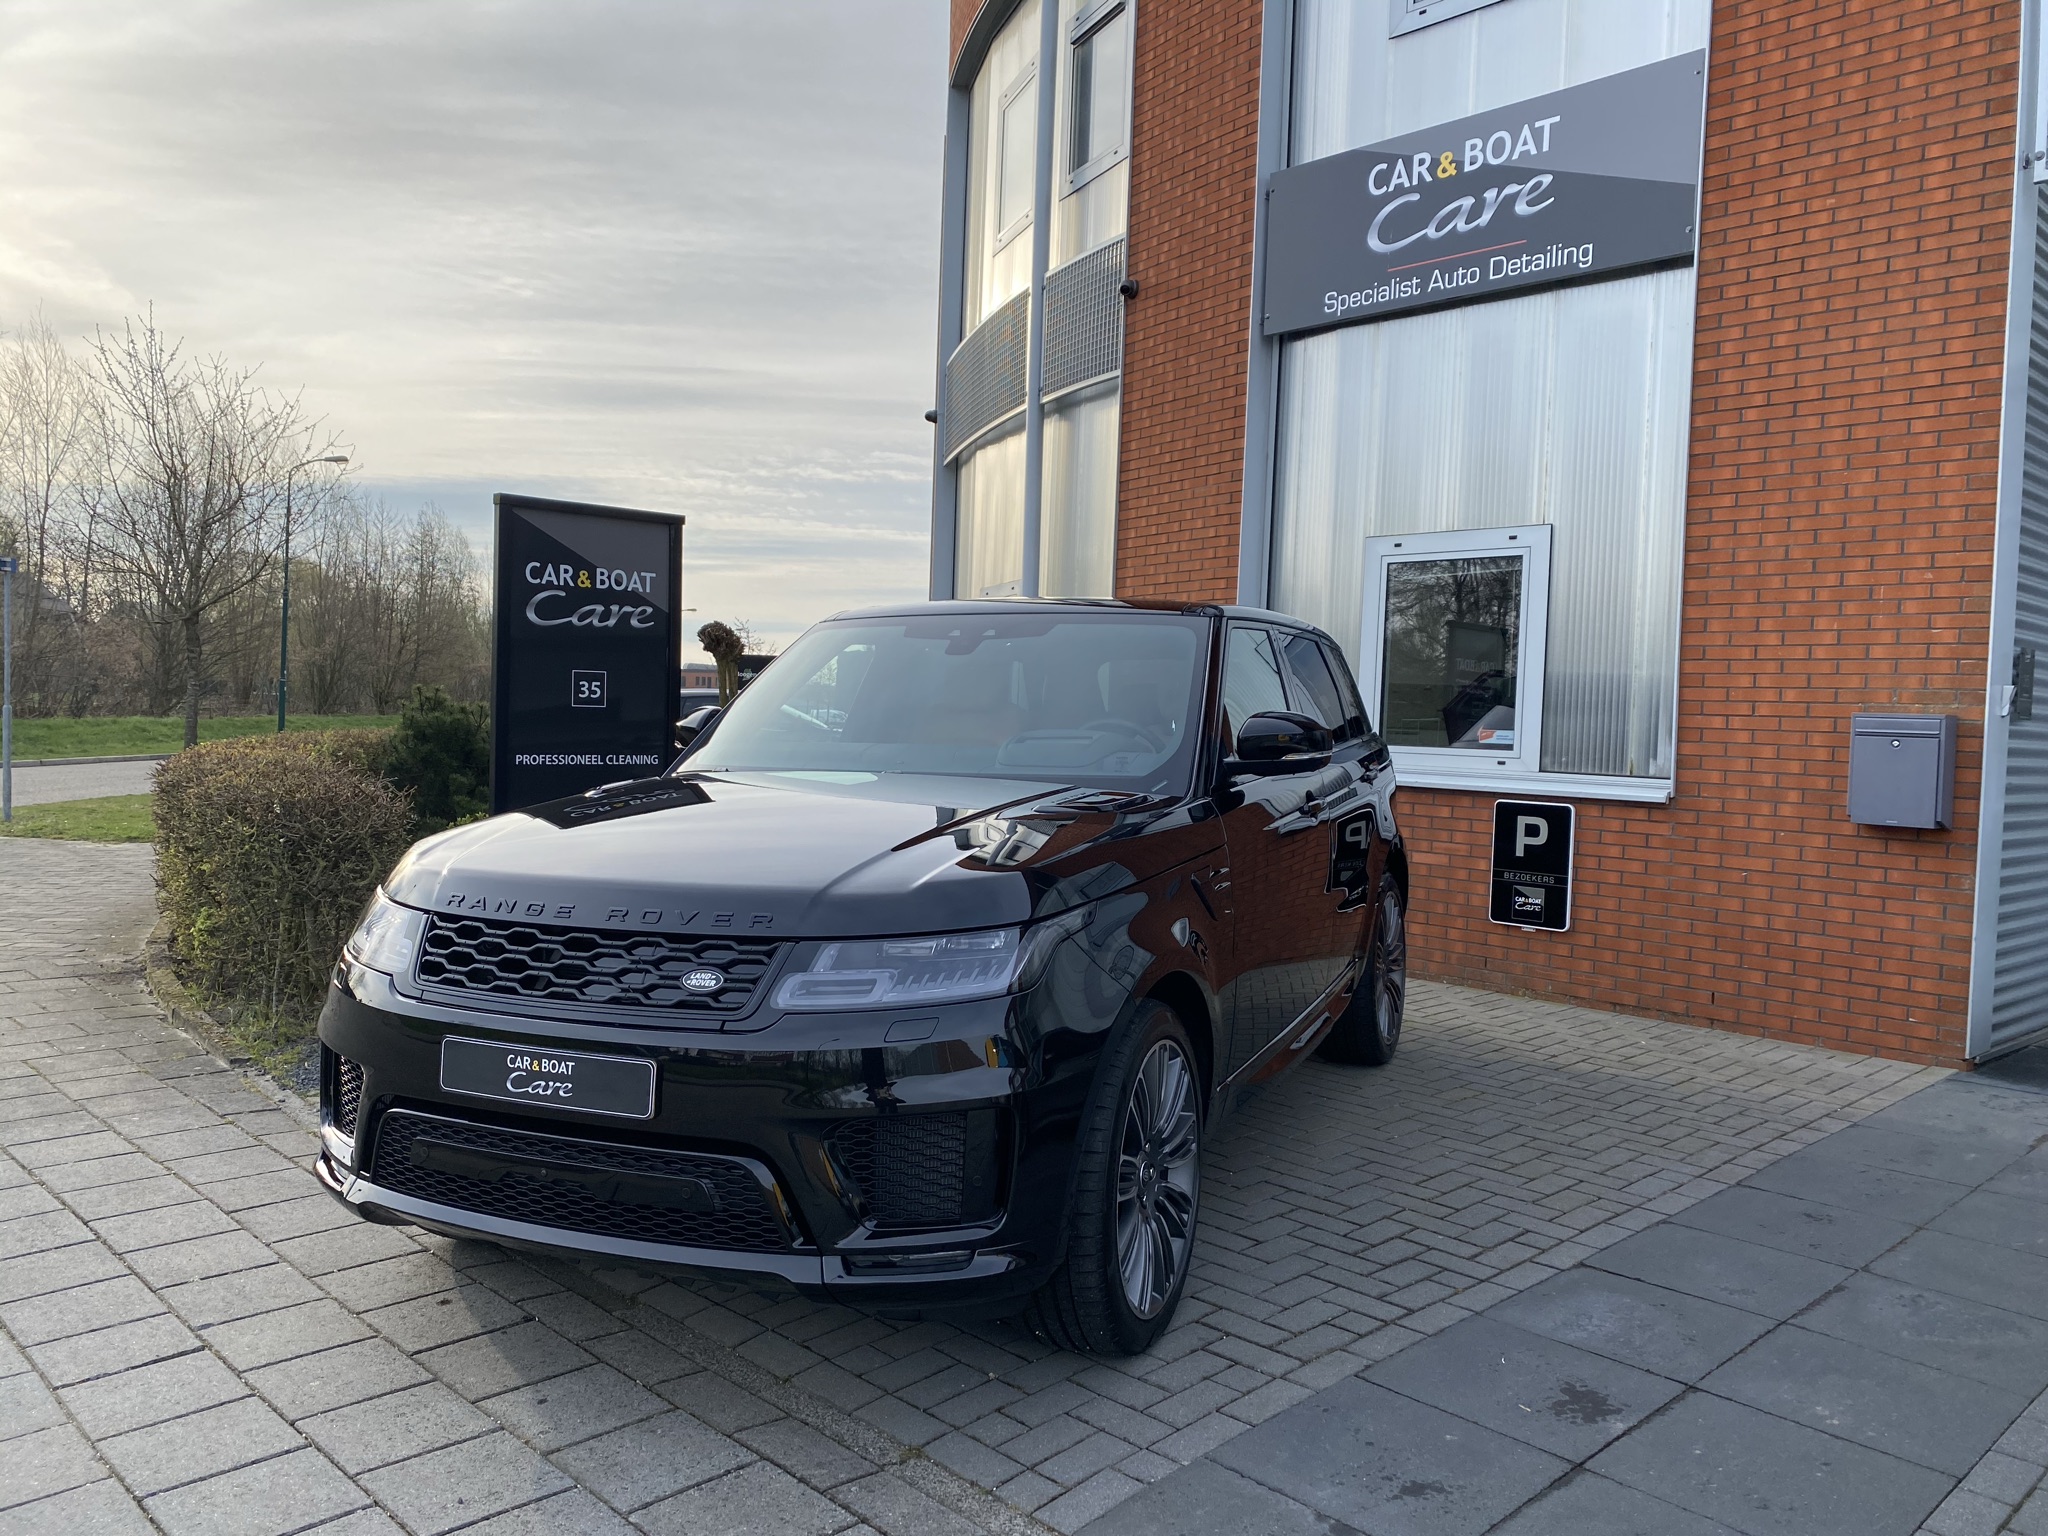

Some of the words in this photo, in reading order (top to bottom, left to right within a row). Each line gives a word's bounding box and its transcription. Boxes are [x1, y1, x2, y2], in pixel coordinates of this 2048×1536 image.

[1366, 172, 1555, 254] Care
[1324, 275, 1421, 316] Specialist
[1427, 265, 1480, 293] Auto
[1489, 241, 1594, 280] Detailing
[525, 589, 655, 629] Care
[578, 680, 601, 698] 35
[515, 754, 603, 765] PROFESSIONEEL
[606, 754, 659, 765] CLEANING
[1515, 815, 1549, 857] P
[1504, 872, 1555, 884] BEZOEKERS
[446, 892, 576, 919] RANGE
[605, 906, 773, 928] ROVER
[1515, 901, 1542, 911] Care
[506, 1071, 573, 1097] Care
